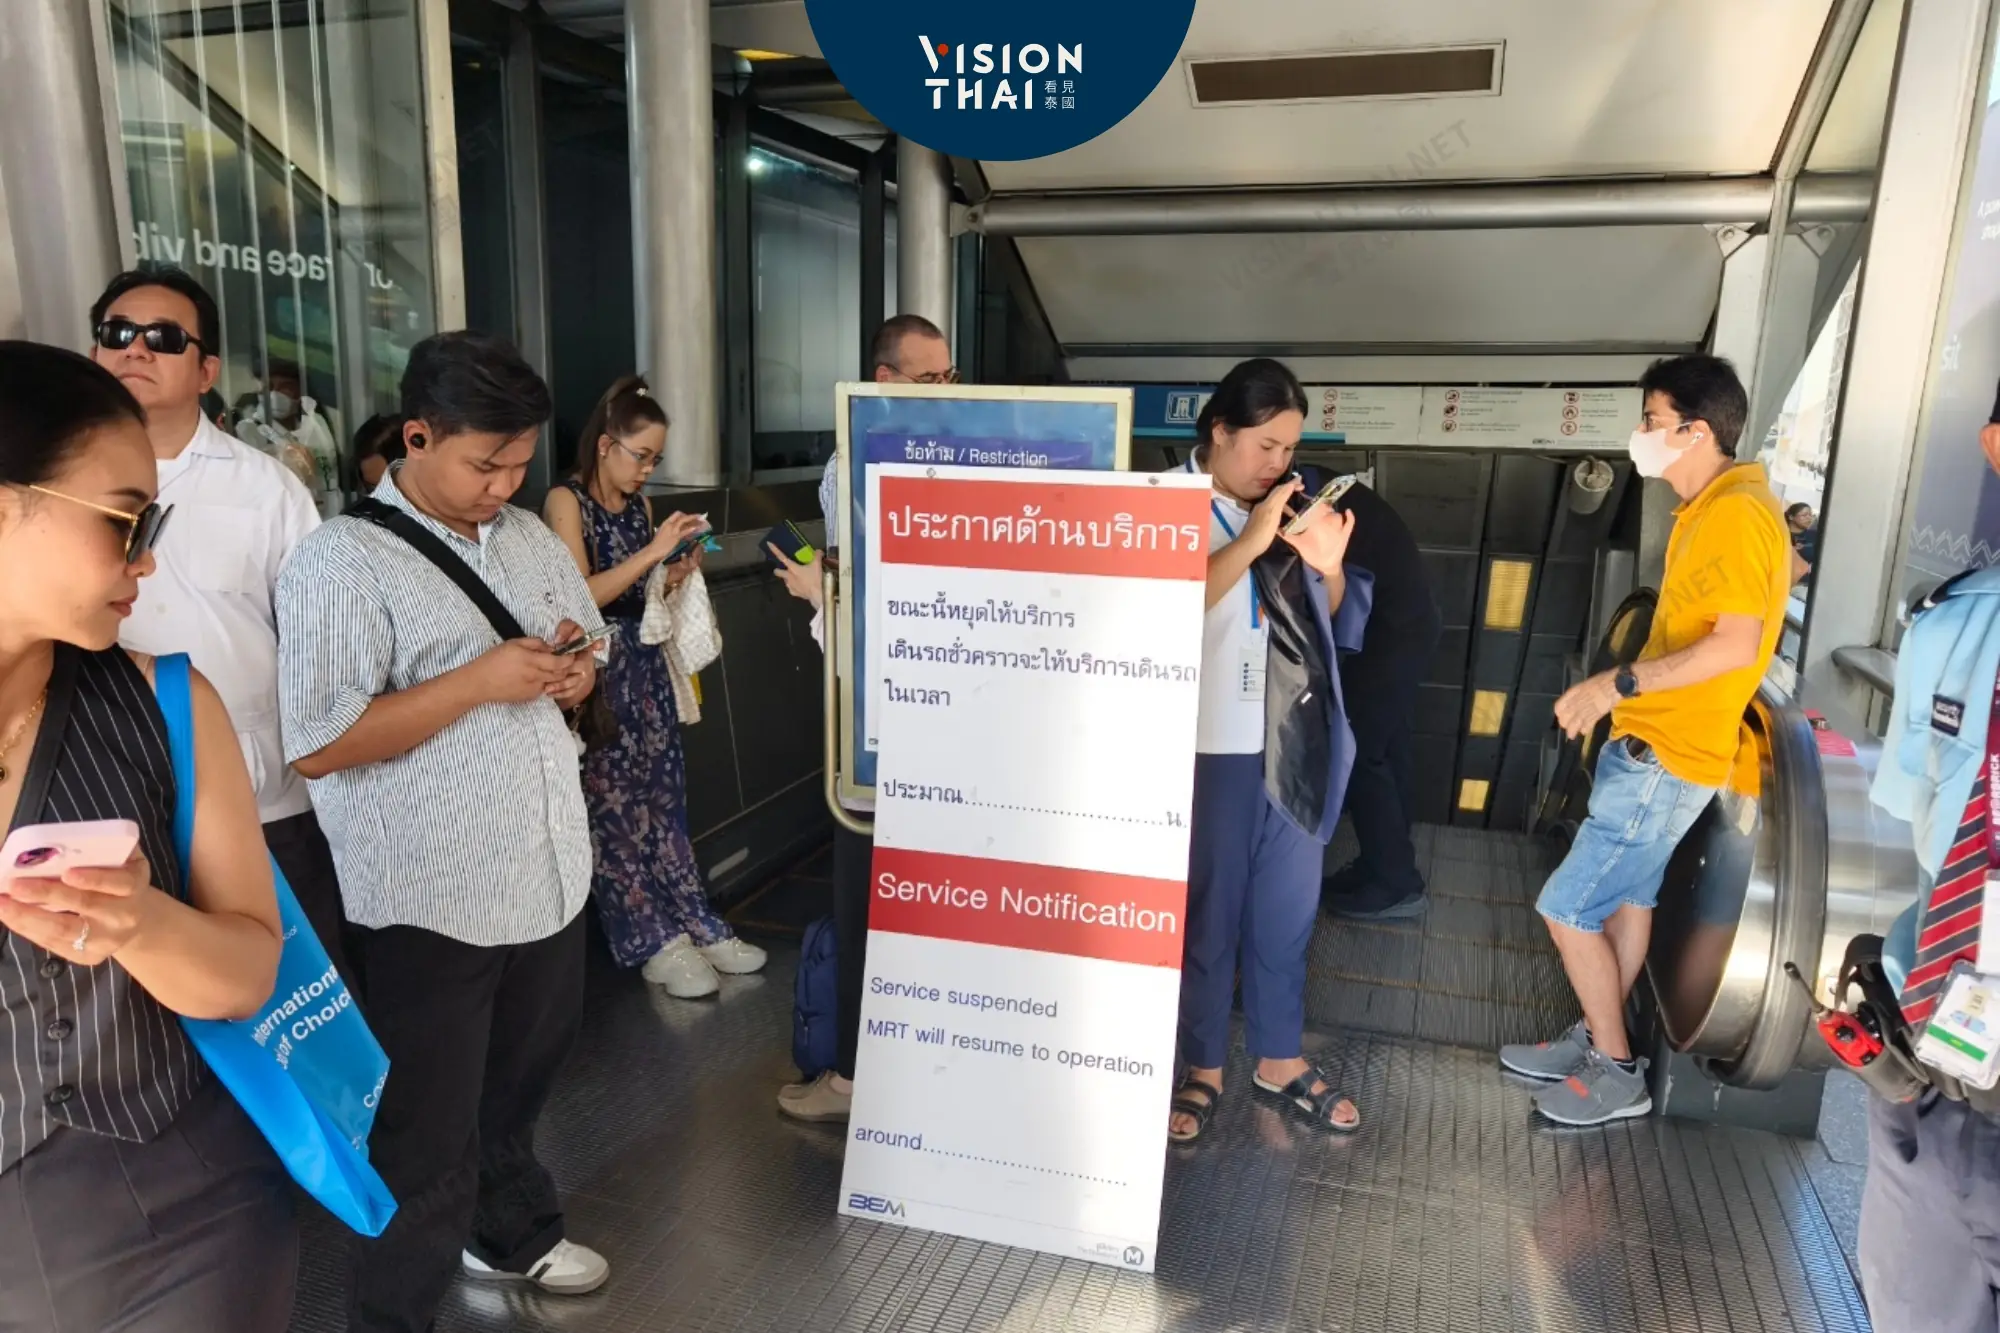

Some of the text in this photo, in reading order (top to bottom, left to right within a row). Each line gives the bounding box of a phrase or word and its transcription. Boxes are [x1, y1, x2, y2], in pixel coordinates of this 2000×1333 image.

[969, 448, 1048, 467] Restriction
[888, 504, 1200, 552] ประกาศด้านบริการ
[887, 591, 1075, 630] ขณะนี้หยุดให้บริการ
[887, 637, 1196, 682] เดินรถชั่วคราวจะให้บริการเดินรถ
[884, 679, 951, 706] ในเวลา
[877, 872, 1177, 933] Service Notification
[870, 977, 1058, 1018] Service suspended
[867, 1019, 1154, 1077] MRT will resume to operation
